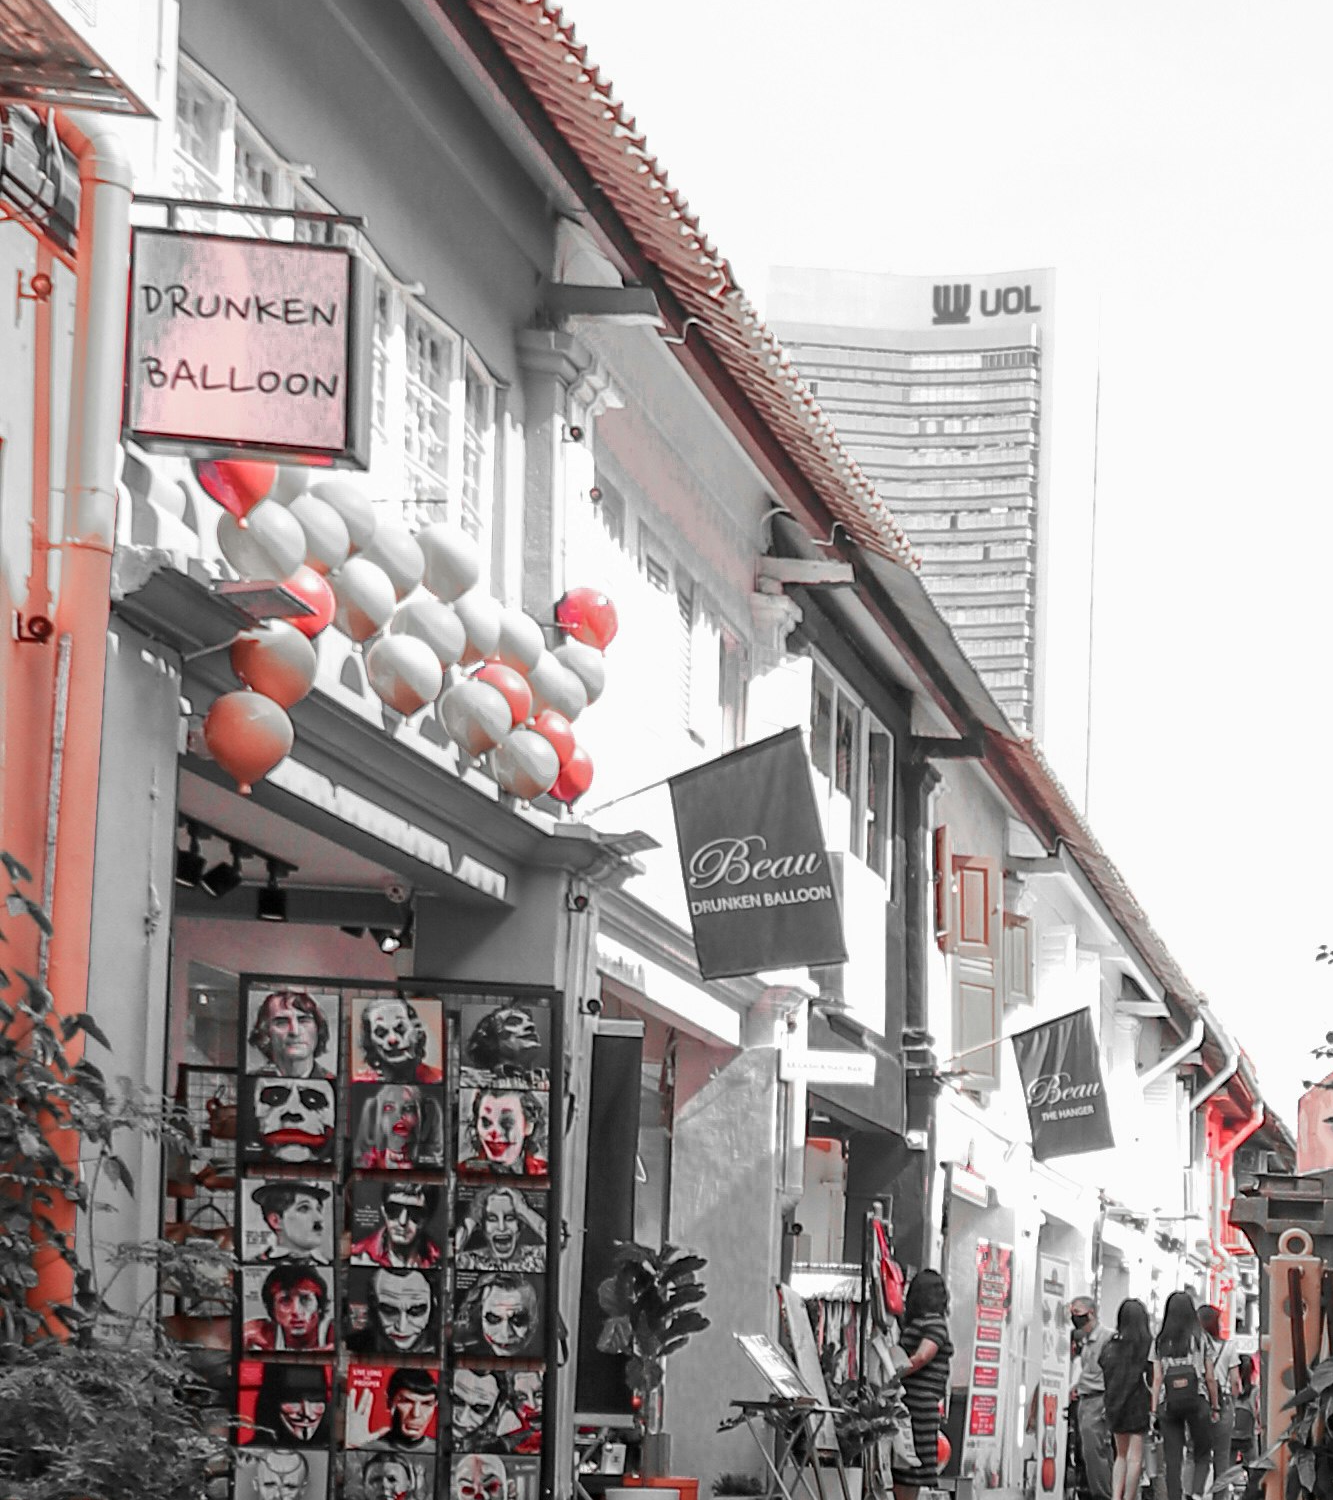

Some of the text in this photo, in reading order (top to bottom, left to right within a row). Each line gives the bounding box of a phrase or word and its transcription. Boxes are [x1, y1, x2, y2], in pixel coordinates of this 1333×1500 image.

[139, 284, 338, 327] DRUNKEN
[980, 284, 1042, 317] UOL
[139, 355, 340, 398] BALLOON
[688, 835, 823, 890] Beau
[691, 884, 832, 917] DRUNKEN BALLOON
[1027, 1071, 1100, 1108] Beau
[1041, 1104, 1095, 1121] THE HANGER
